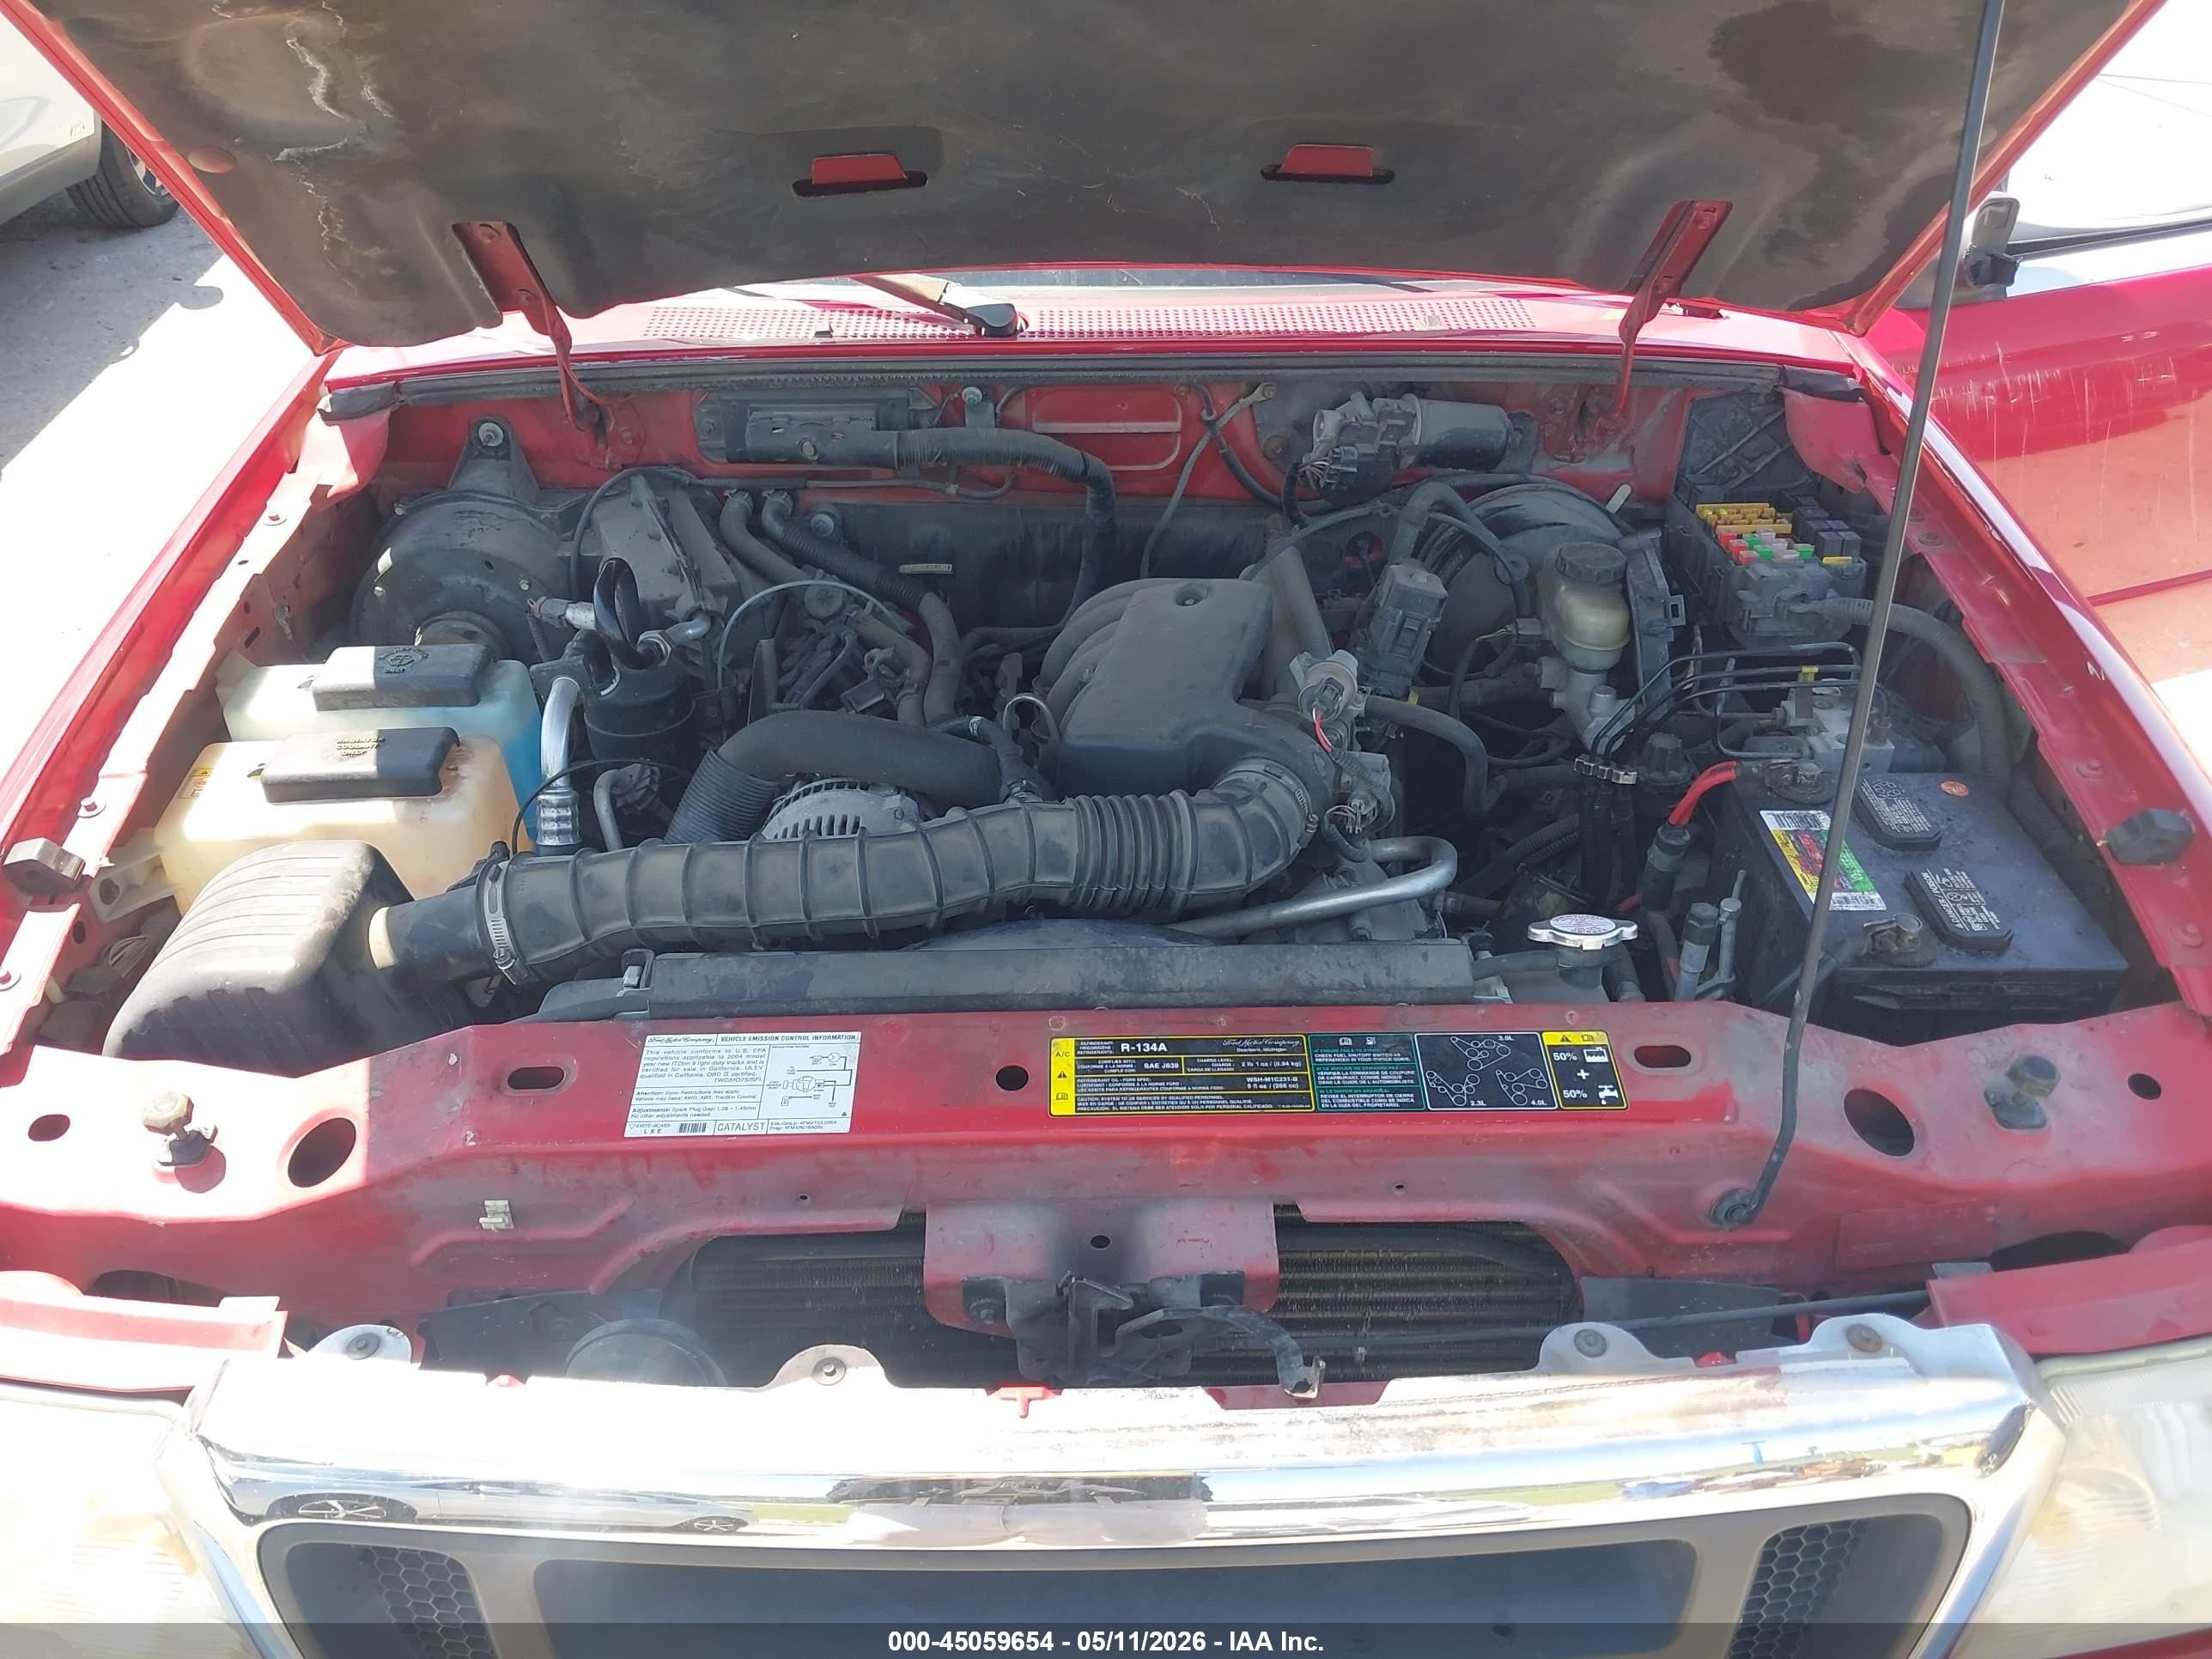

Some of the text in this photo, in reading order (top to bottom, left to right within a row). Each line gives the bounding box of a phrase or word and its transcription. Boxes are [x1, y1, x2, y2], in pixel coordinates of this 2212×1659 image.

[1121, 1043, 1167, 1052] R-134A
[1553, 1053, 1577, 1061] 50%
[1563, 1090, 1587, 1098] 50%
[717, 1122, 766, 1132] CATALYST
